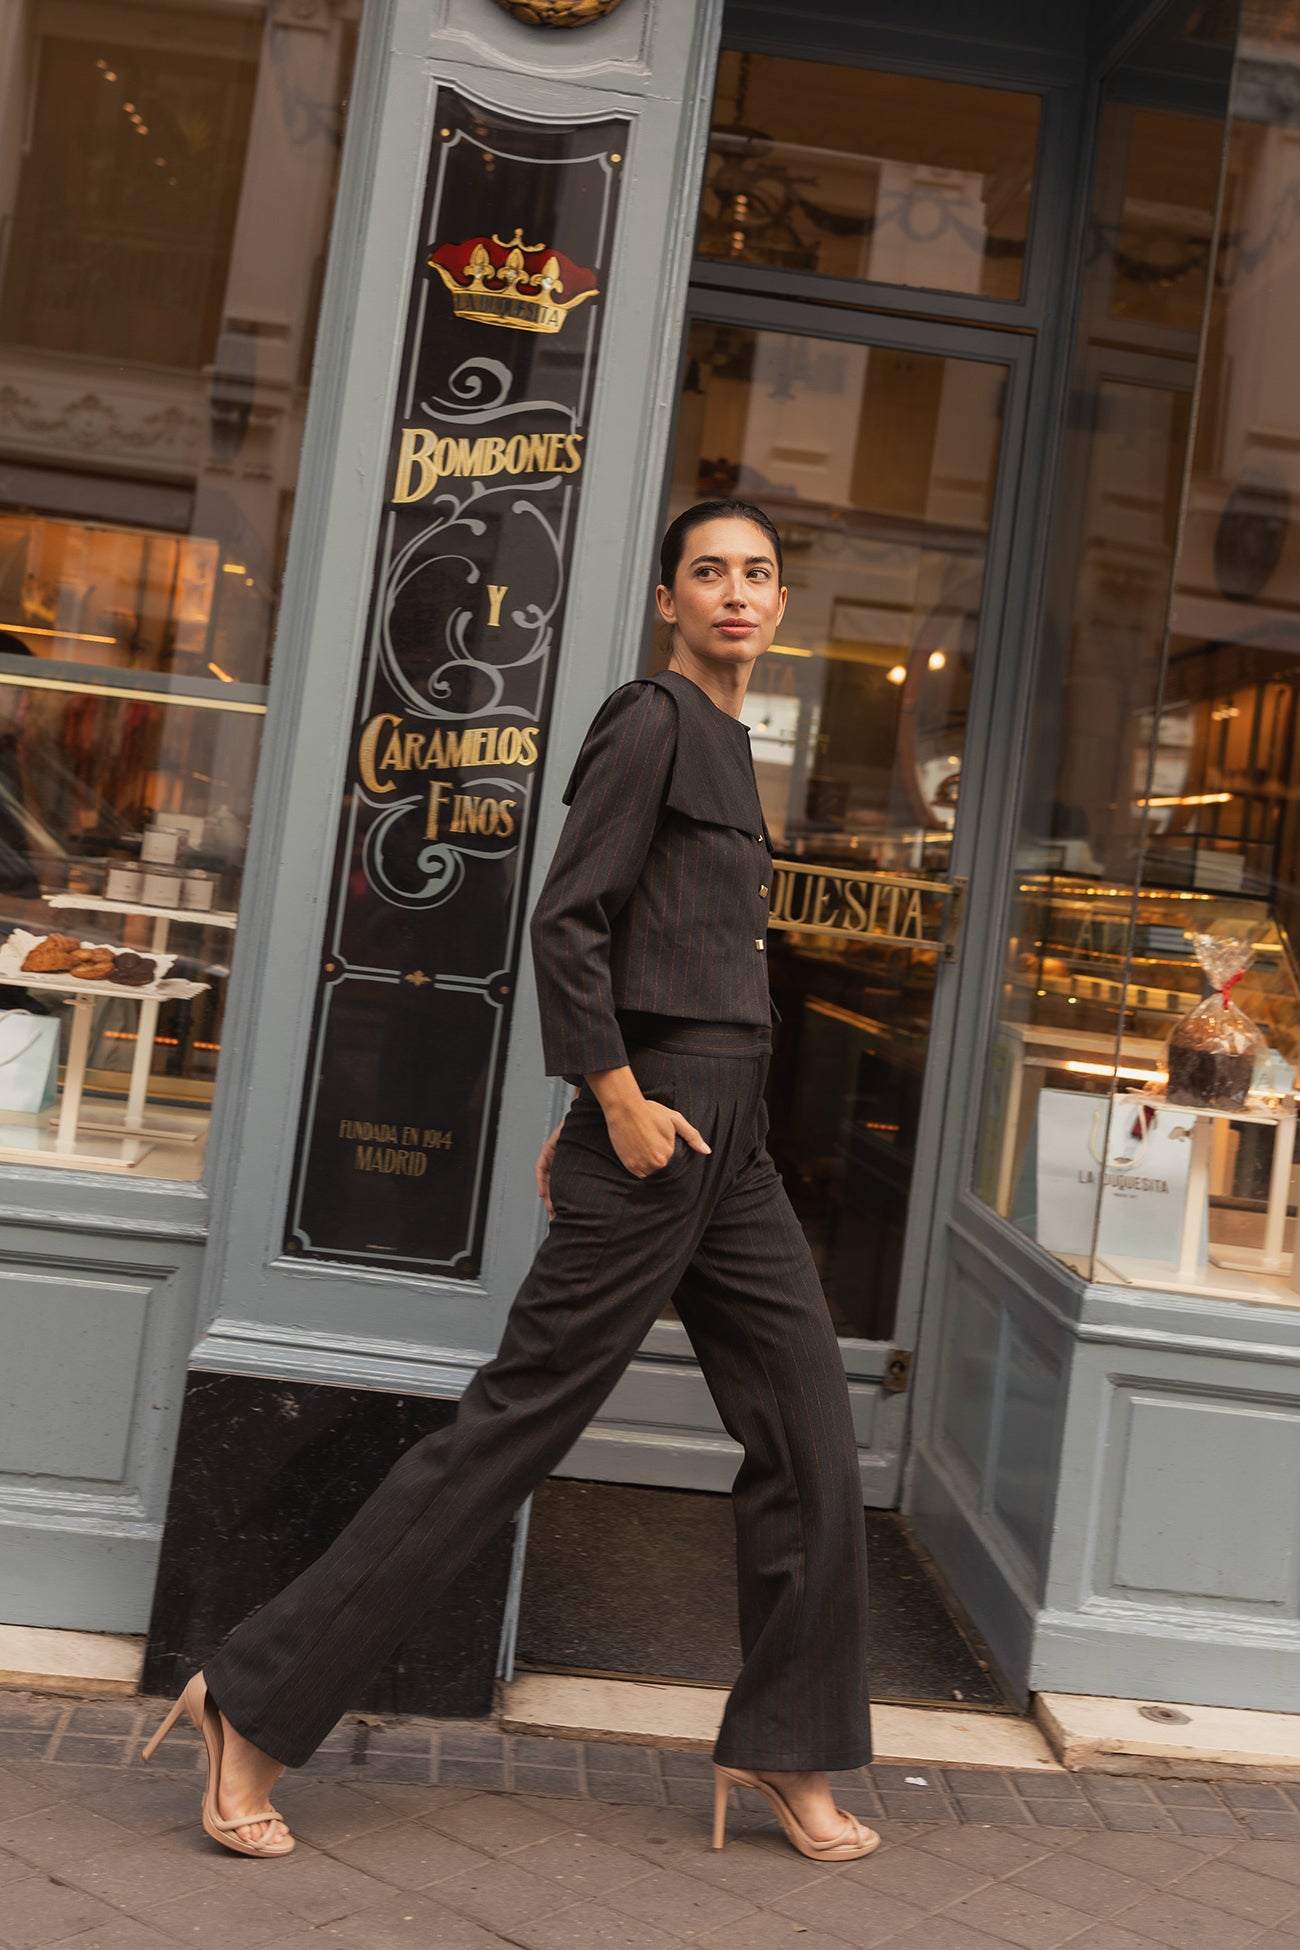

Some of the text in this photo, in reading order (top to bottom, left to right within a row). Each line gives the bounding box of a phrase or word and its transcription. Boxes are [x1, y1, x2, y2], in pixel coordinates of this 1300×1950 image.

[391, 428, 584, 503] BOMBONES
[487, 585, 509, 627] Y
[359, 713, 540, 793] CARAMELOS
[422, 780, 517, 840] FINOS
[769, 870, 923, 940] UESITA
[338, 1119, 399, 1144] FUNDADA
[401, 1126, 420, 1146] EN
[354, 1145, 428, 1177] MADRID
[1078, 1170, 1095, 1184] LA
